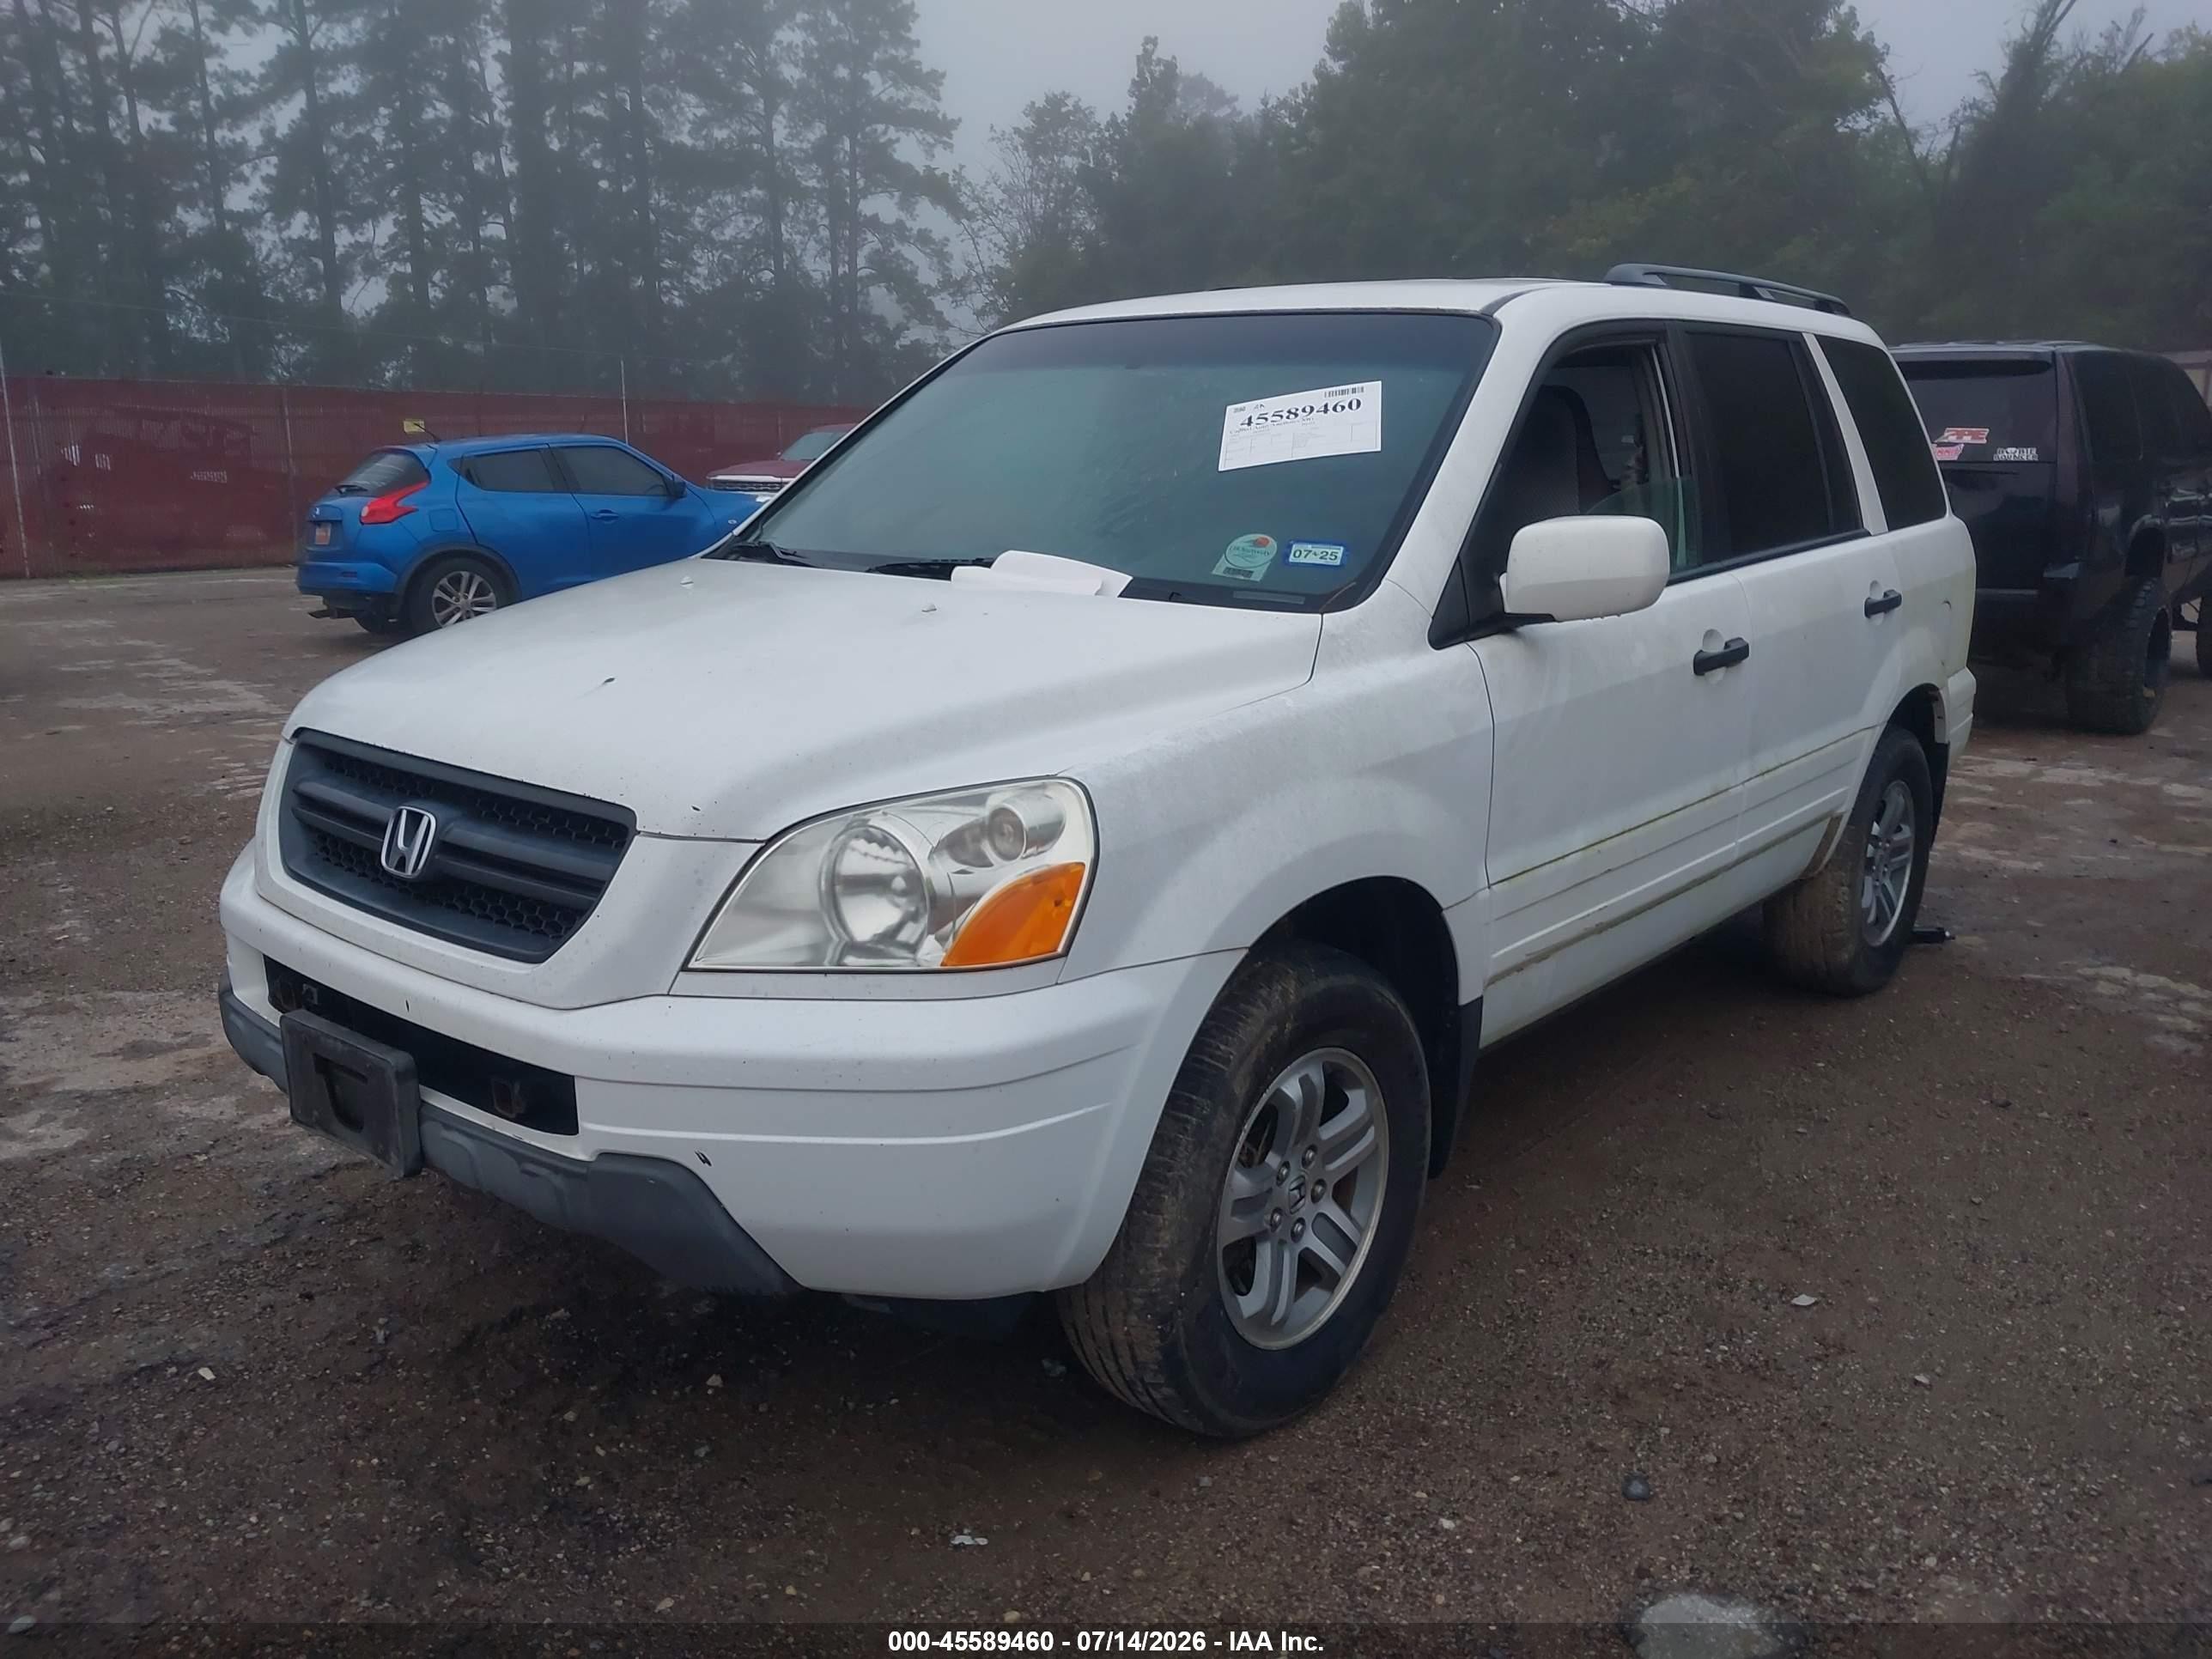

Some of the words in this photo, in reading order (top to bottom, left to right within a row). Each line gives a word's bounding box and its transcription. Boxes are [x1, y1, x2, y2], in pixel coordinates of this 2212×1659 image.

[1239, 398, 1362, 428] 45589460
[1292, 549, 1313, 559] 07
[1318, 550, 1340, 561] 25
